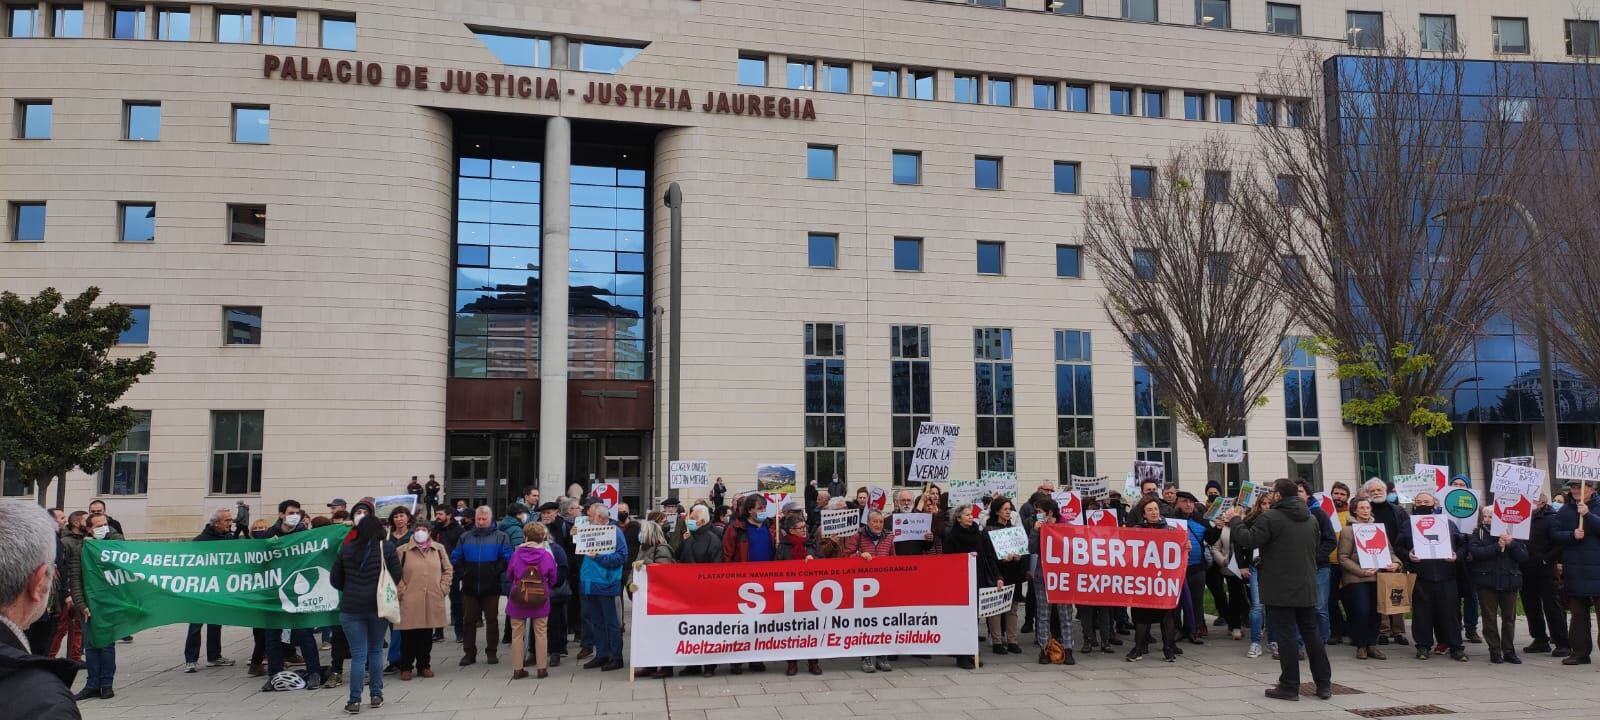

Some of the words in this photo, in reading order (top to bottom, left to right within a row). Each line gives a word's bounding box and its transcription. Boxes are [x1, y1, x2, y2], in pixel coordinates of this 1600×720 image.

[263, 53, 383, 86] PALACIO
[395, 64, 429, 89] DE
[440, 69, 560, 100] JUSTICIA
[583, 81, 693, 111] JUSTIZIA
[702, 91, 817, 120] JAUREGIA
[916, 447, 938, 460] DECIR
[941, 449, 950, 460] LA
[931, 436, 945, 446] POR
[1563, 449, 1590, 464] STOP
[916, 463, 949, 480] VERDAD
[846, 514, 858, 527] NO
[100, 550, 140, 564] STOP
[142, 551, 242, 567] ABELTZAINTZA
[244, 538, 330, 564] INDUSTRIALA
[1045, 535, 1182, 570] LIBERTAD
[226, 567, 283, 593] ORAIN
[697, 572, 747, 580] PLATAFORMA
[749, 570, 785, 579] NAVARRA
[798, 569, 829, 577] CONTRA
[830, 568, 841, 576] DE
[842, 568, 857, 576] LAS
[858, 564, 919, 575] MACROGRANJAS
[1046, 571, 1070, 592] DE
[1076, 570, 1180, 598] EXPRESIÓN
[302, 596, 325, 607] STOP
[737, 576, 881, 616] STOP
[677, 620, 750, 636] Ganadería
[754, 616, 820, 635] Industrial
[831, 615, 850, 629] No
[854, 615, 879, 628] nos
[882, 611, 939, 627] callarán
[675, 639, 752, 655] Abeltzaintza
[754, 634, 818, 652] Industriala
[826, 633, 842, 647] Ez
[843, 631, 892, 650] gaituzte
[894, 629, 942, 645] isilduko
